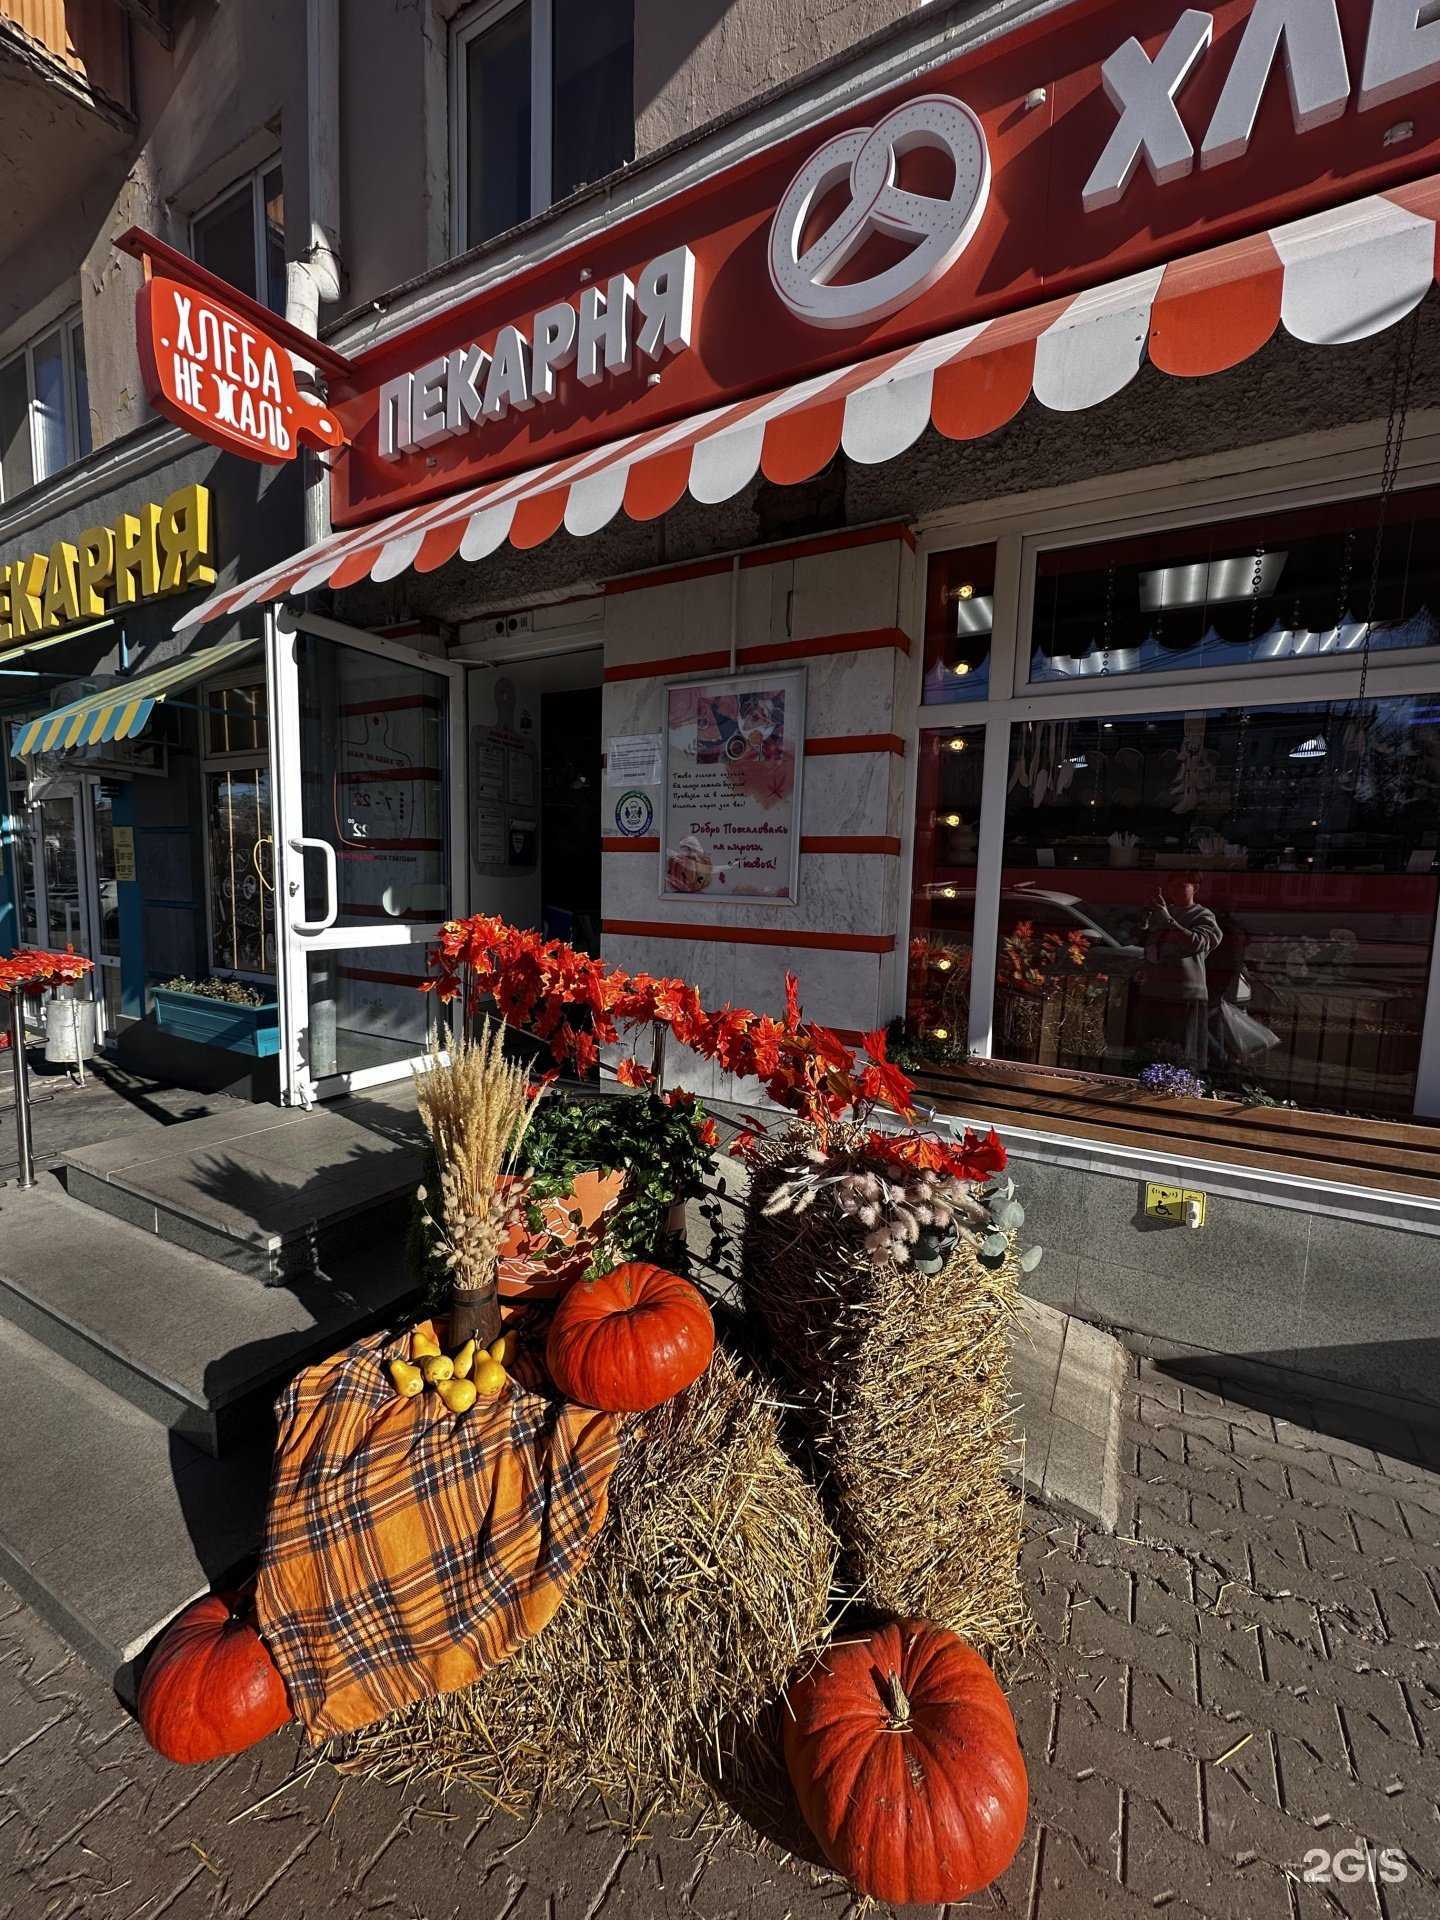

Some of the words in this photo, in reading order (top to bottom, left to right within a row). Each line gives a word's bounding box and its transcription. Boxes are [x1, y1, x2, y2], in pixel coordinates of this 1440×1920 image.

[173, 290, 282, 405] ХЛЕБА
[378, 246, 696, 464] ПЕКАРНЯ
[173, 352, 207, 413] НЕ
[211, 373, 290, 451] ЖАЛЬ
[690, 822, 720, 837] Добро
[723, 822, 788, 834] Пожаловать
